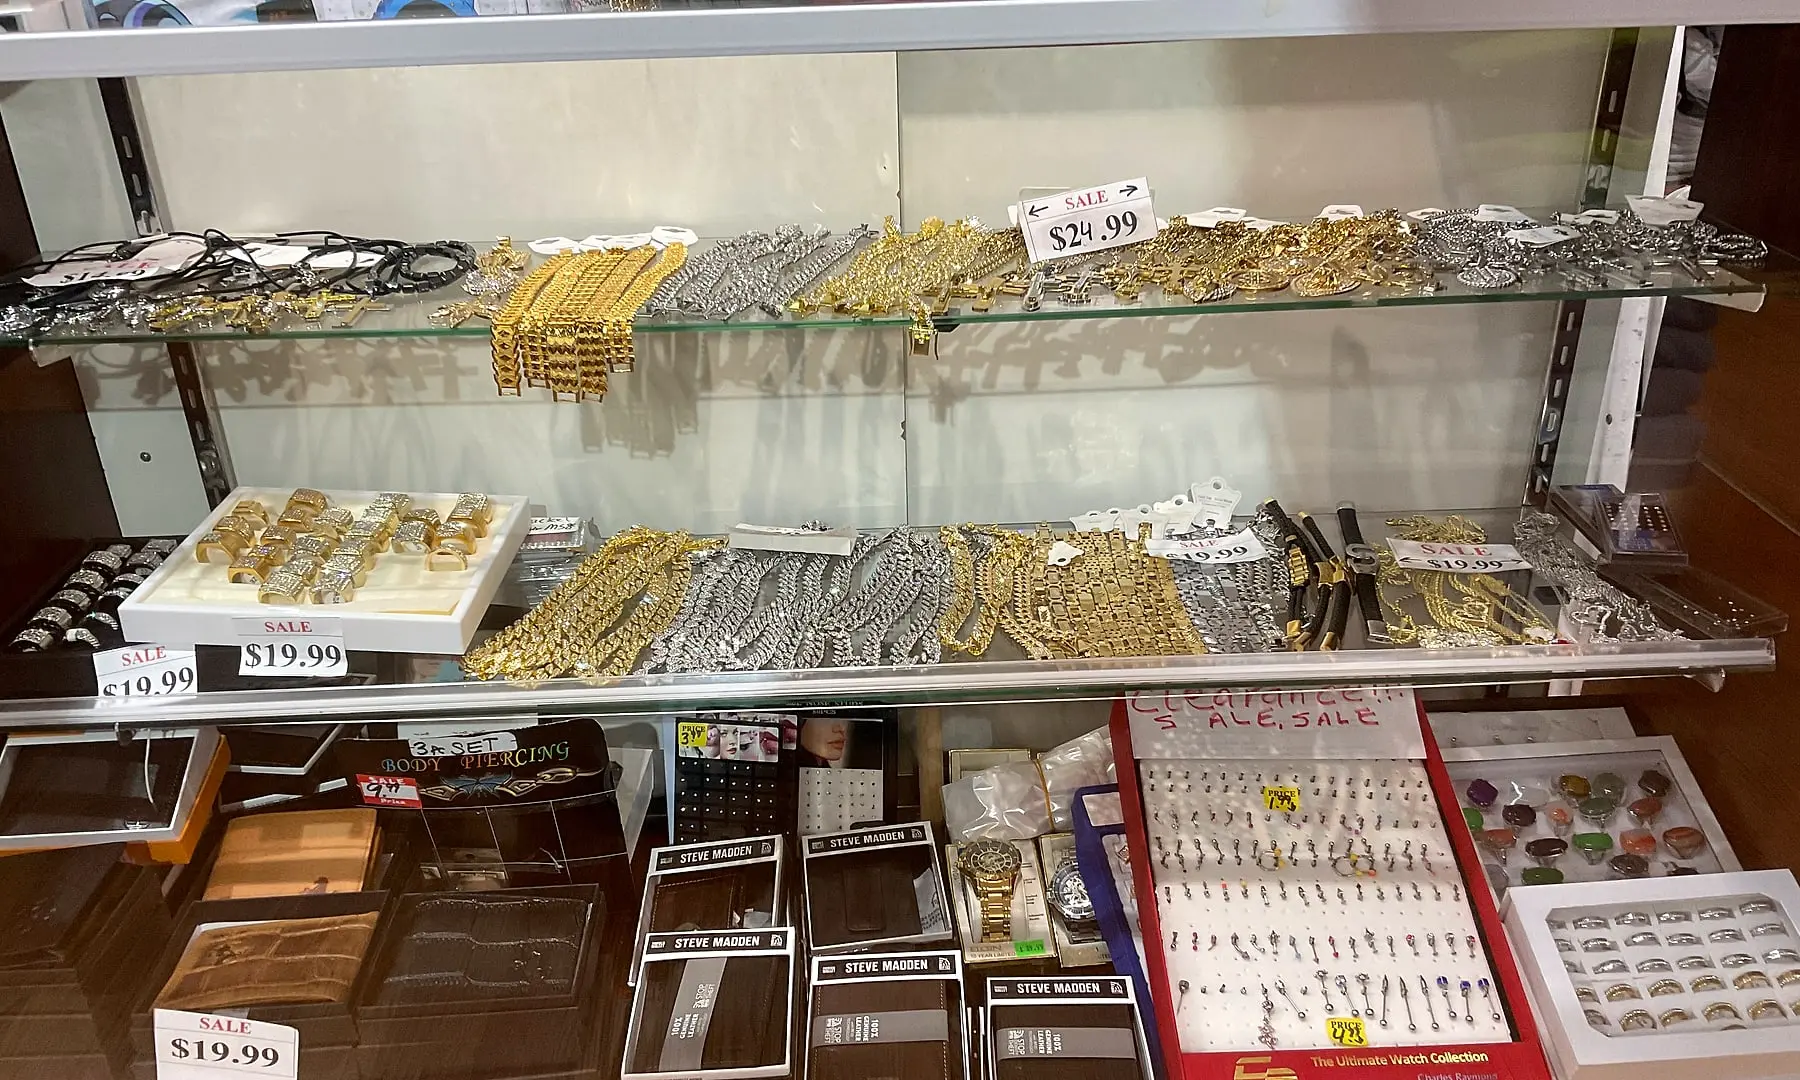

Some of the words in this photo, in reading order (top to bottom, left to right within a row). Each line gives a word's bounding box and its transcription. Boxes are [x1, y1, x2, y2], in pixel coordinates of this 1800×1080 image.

[1065, 190, 1109, 210] SALE
[1049, 210, 1138, 251] $24.99
[1179, 541, 1218, 549] SALE
[1420, 544, 1492, 556] SALE
[1427, 558, 1503, 570] $19.99
[265, 621, 312, 633] SALE
[121, 645, 167, 667] SALE
[245, 643, 341, 669] $19.99
[103, 666, 194, 696] $19.99
[682, 725, 706, 733] PRICE
[451, 738, 499, 756] SET
[381, 756, 443, 773] BODY
[460, 741, 570, 771] PIERCING
[369, 776, 405, 785] SALE
[1268, 790, 1296, 798] PRICE
[830, 835, 861, 848] STEVE
[863, 831, 905, 845] MADDEN
[680, 850, 709, 864] STEVE
[712, 845, 752, 860] MADDEN
[674, 938, 709, 949] STEVE
[712, 935, 760, 948] MADDEN
[845, 961, 878, 974] STEVE
[882, 959, 929, 972] MADDEN
[1017, 983, 1051, 994] STEVE
[1054, 982, 1101, 994] MADDEN
[199, 1017, 252, 1035] SALE
[671, 1016, 683, 1036] 100%
[870, 1018, 880, 1038] 100%
[1330, 1020, 1362, 1030] PRICE
[833, 1026, 842, 1043] STOP
[1053, 1033, 1062, 1051] 100%
[171, 1038, 280, 1068] $19.99
[1016, 1038, 1026, 1055] STOP
[1311, 1055, 1334, 1068] The
[1336, 1054, 1388, 1067] Ultimate
[1391, 1052, 1429, 1065] Watch
[1431, 1051, 1489, 1063] Collection
